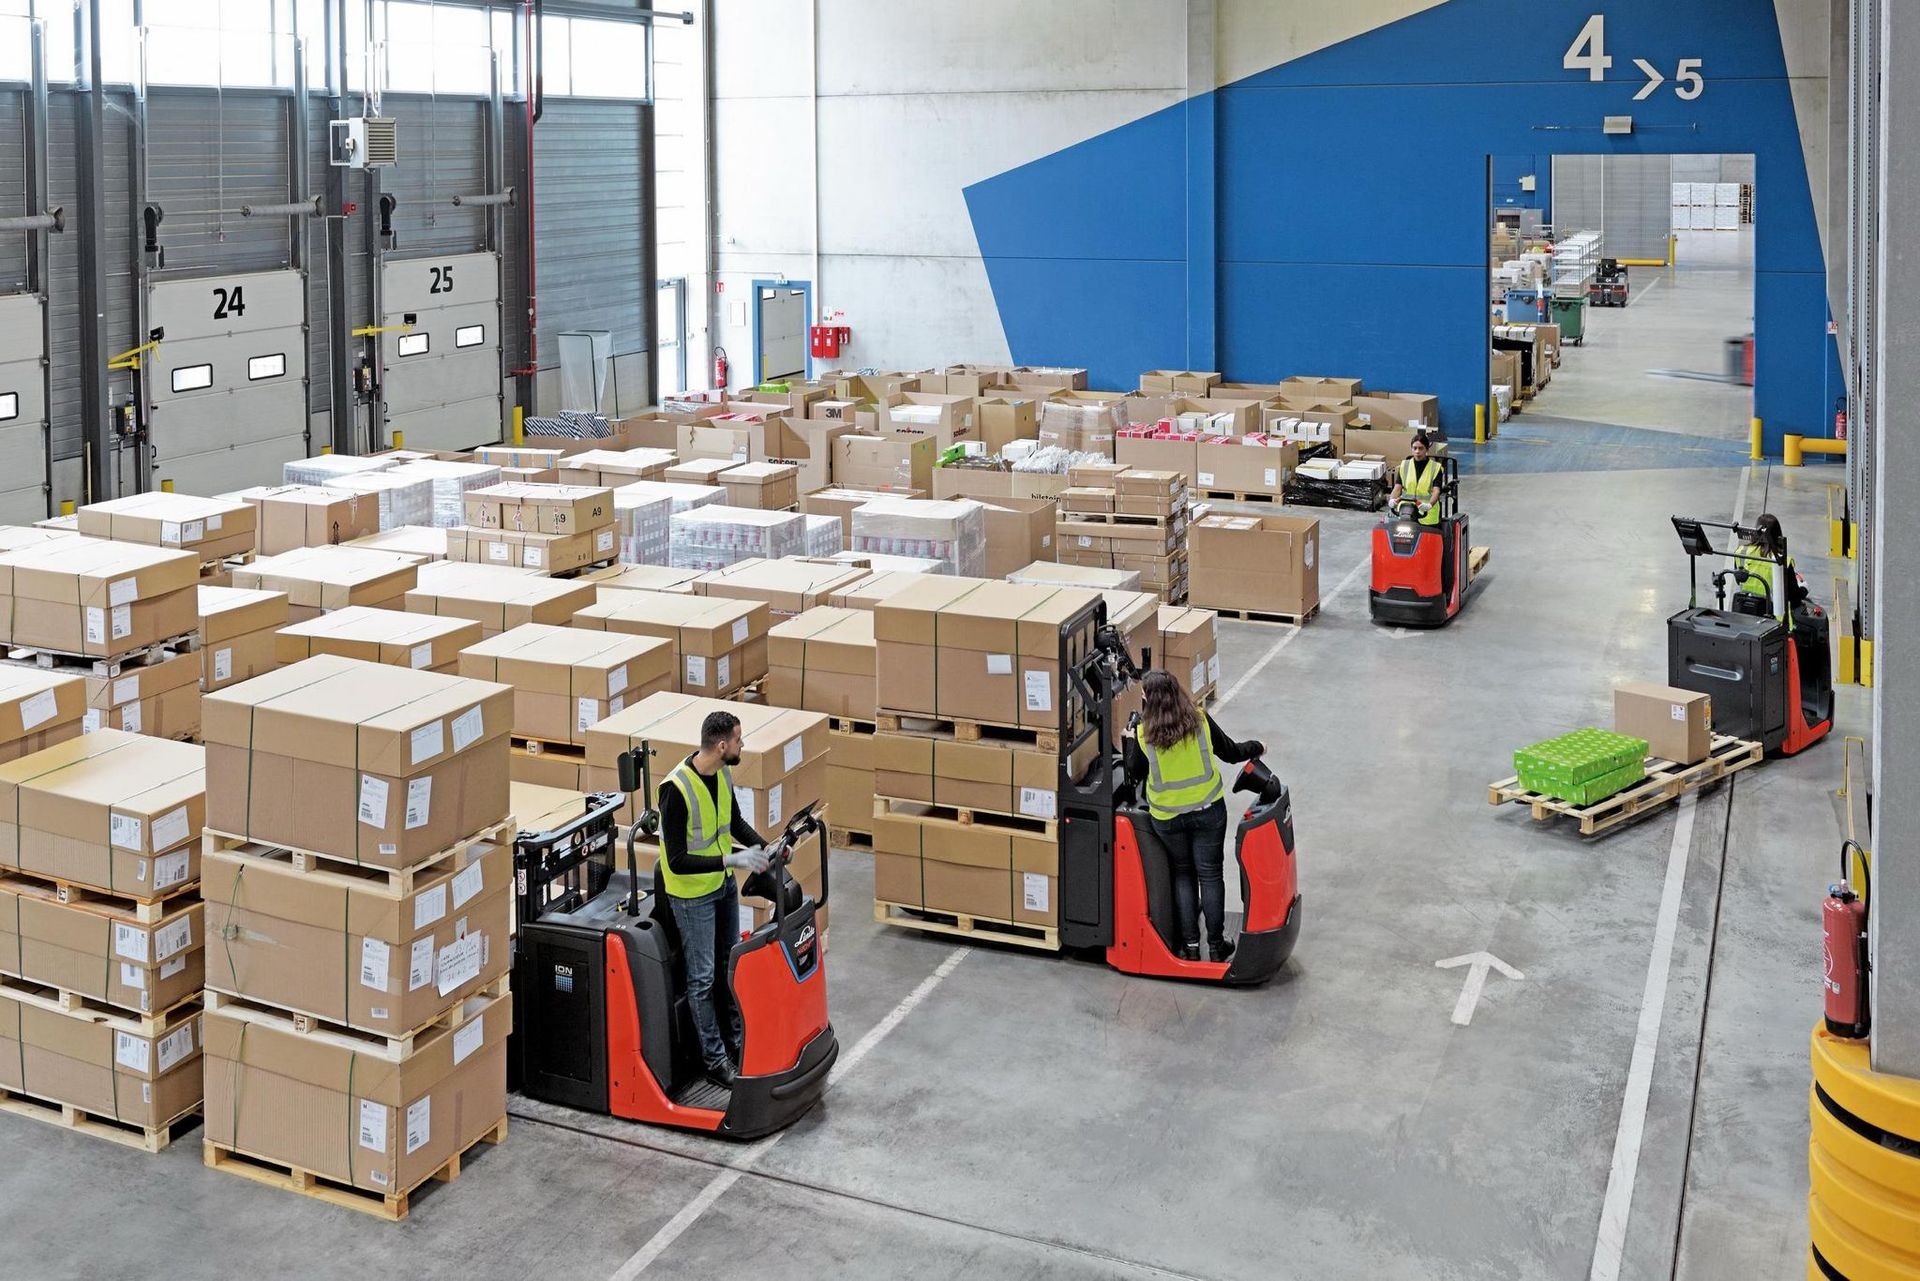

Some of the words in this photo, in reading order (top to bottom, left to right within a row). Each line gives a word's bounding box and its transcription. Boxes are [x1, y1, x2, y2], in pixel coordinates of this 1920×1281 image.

[1563, 14, 1612, 81] 4
[1674, 59, 1704, 100] 5
[430, 266, 453, 293] 25
[213, 286, 245, 319] 24
[826, 408, 842, 418] 3M
[592, 507, 602, 517] A9
[555, 964, 573, 974] ION
